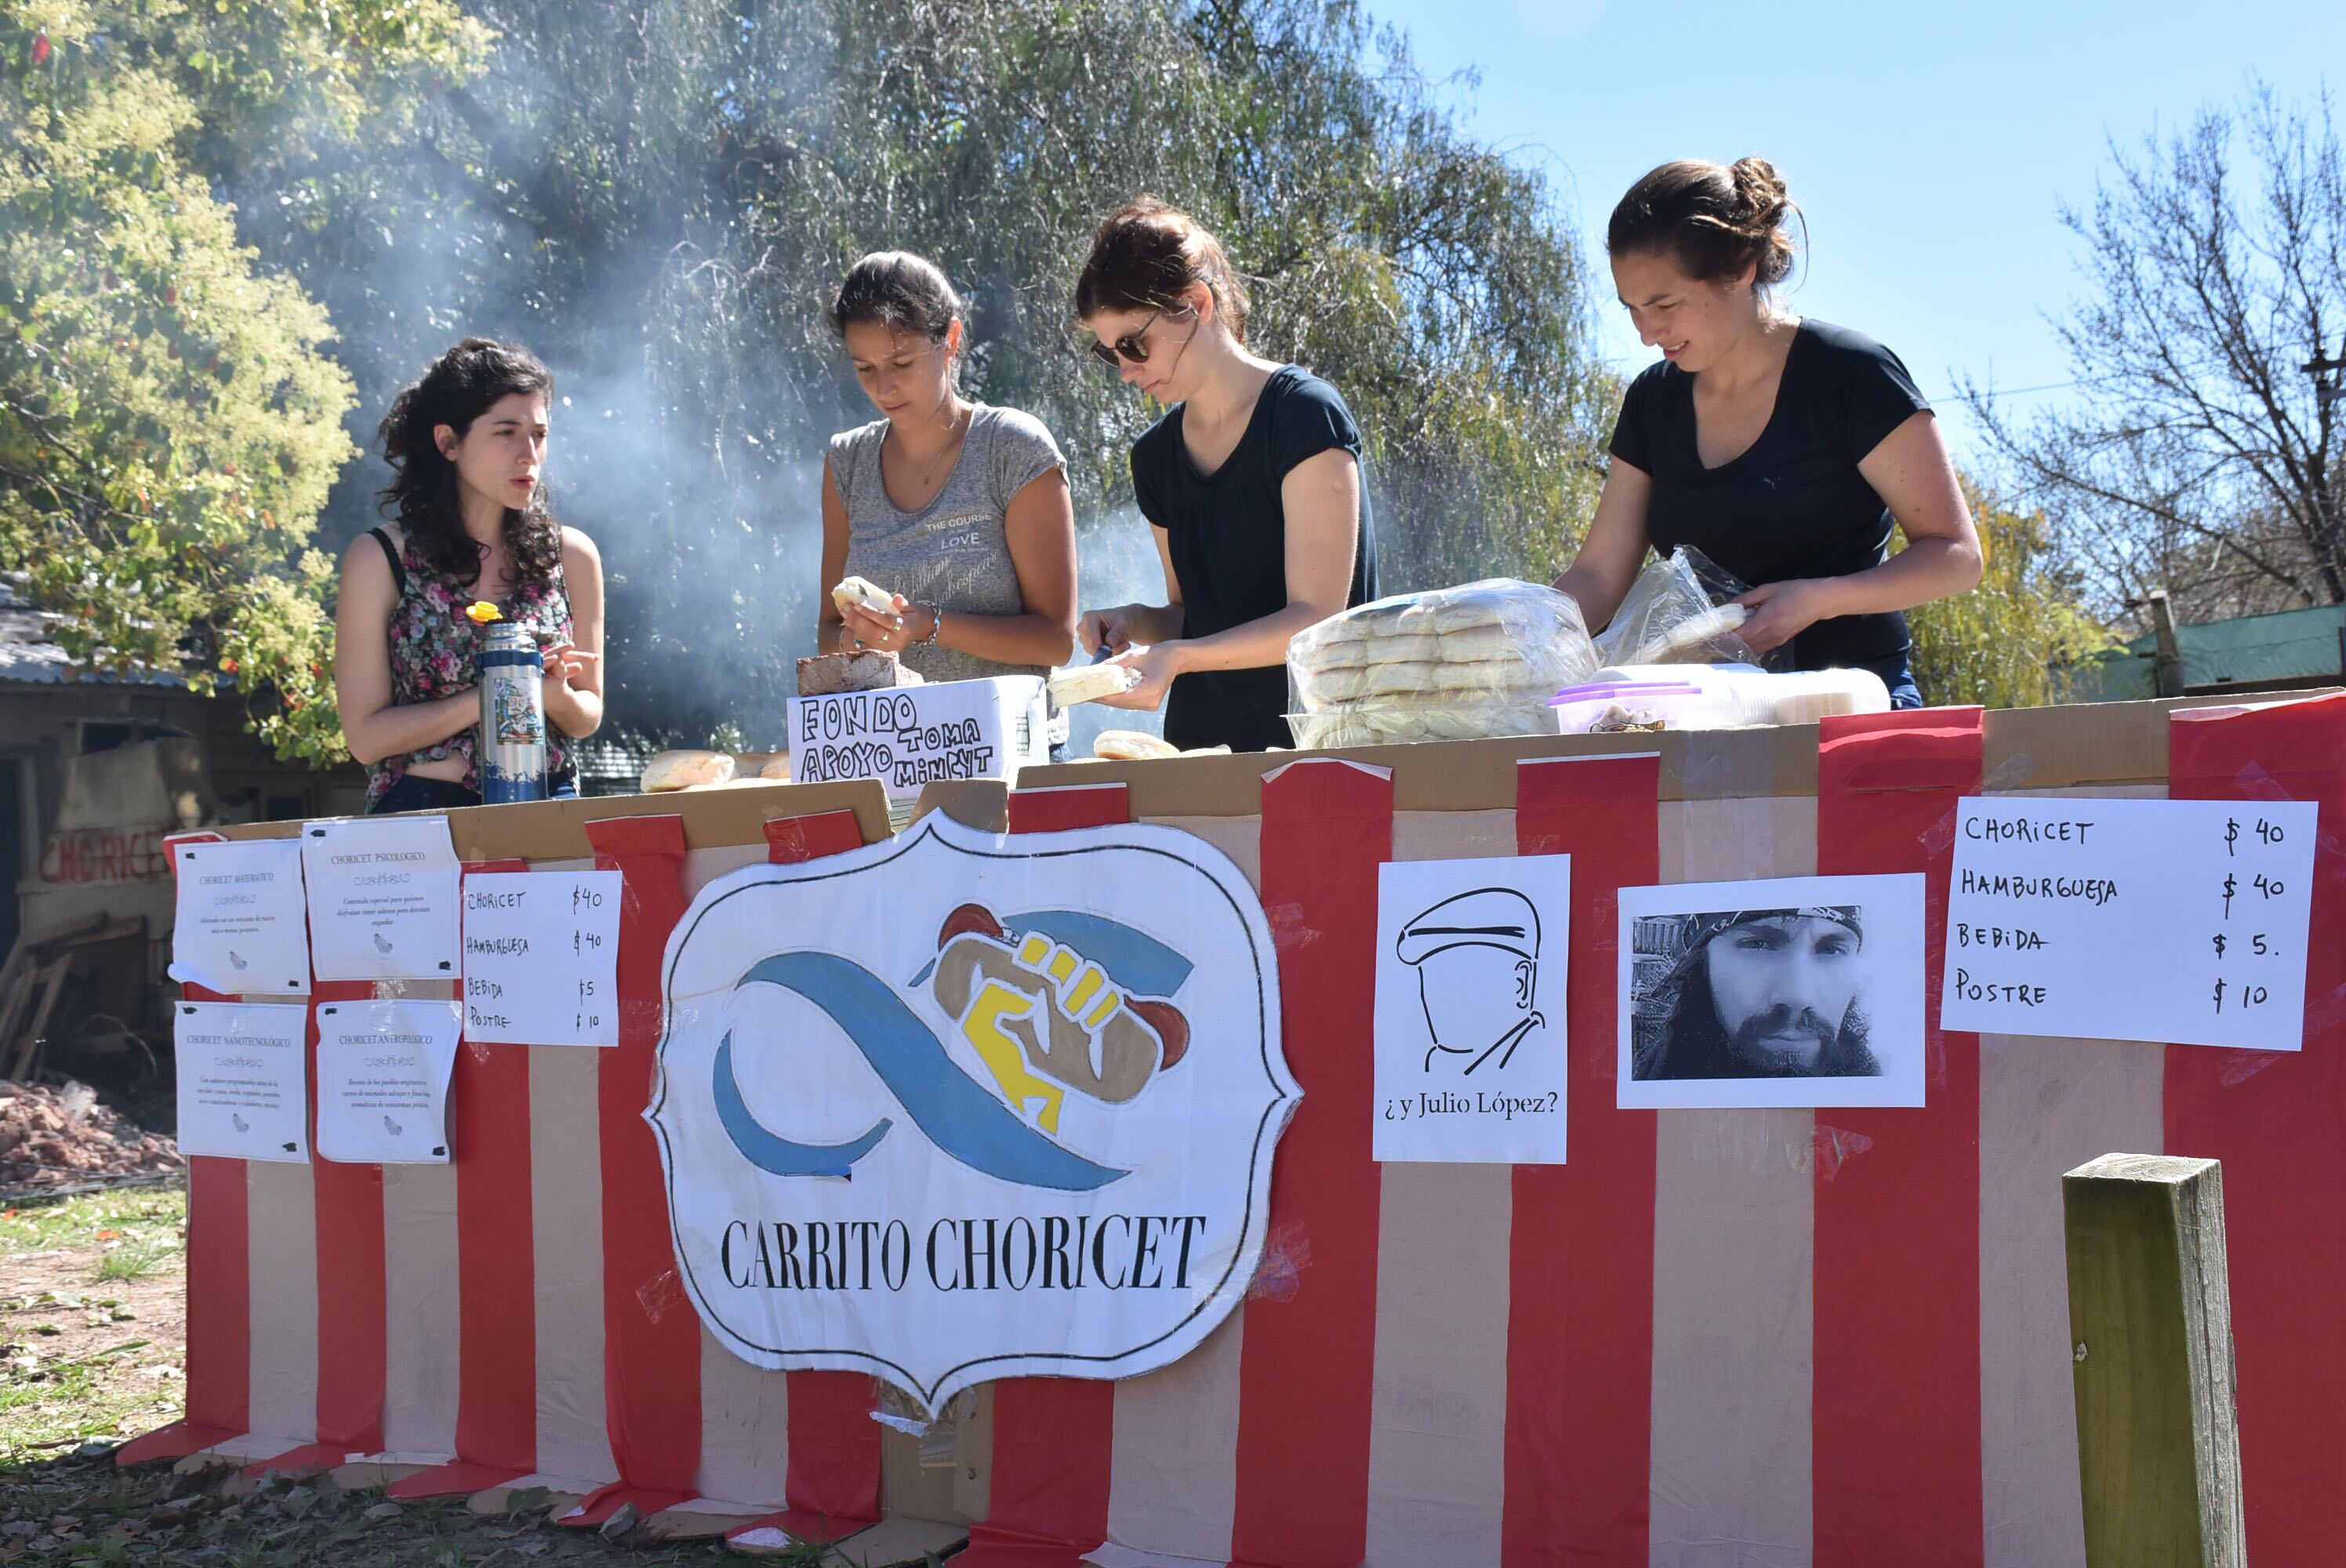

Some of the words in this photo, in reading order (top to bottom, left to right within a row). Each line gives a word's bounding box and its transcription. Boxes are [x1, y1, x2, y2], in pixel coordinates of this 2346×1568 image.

[926, 521, 946, 532] THE
[949, 513, 992, 528] COURSE
[942, 532, 980, 549] LOVE
[800, 693, 917, 742] FONDO
[897, 717, 981, 753] TOMA
[800, 741, 894, 783] APOYO
[331, 853, 372, 865] CHORICET
[1961, 868, 2119, 907] HAMBURGUESA
[466, 935, 529, 956] HAMBURGUESA
[1955, 967, 2047, 1007] POSTRE
[470, 1005, 513, 1029] POSTRE
[1385, 1098, 1414, 1121] ¿y
[1418, 1091, 1471, 1119] Julio
[1476, 1091, 1559, 1121] López?
[720, 1218, 911, 1292] CARRITO
[925, 1213, 1208, 1292] CHORICET
